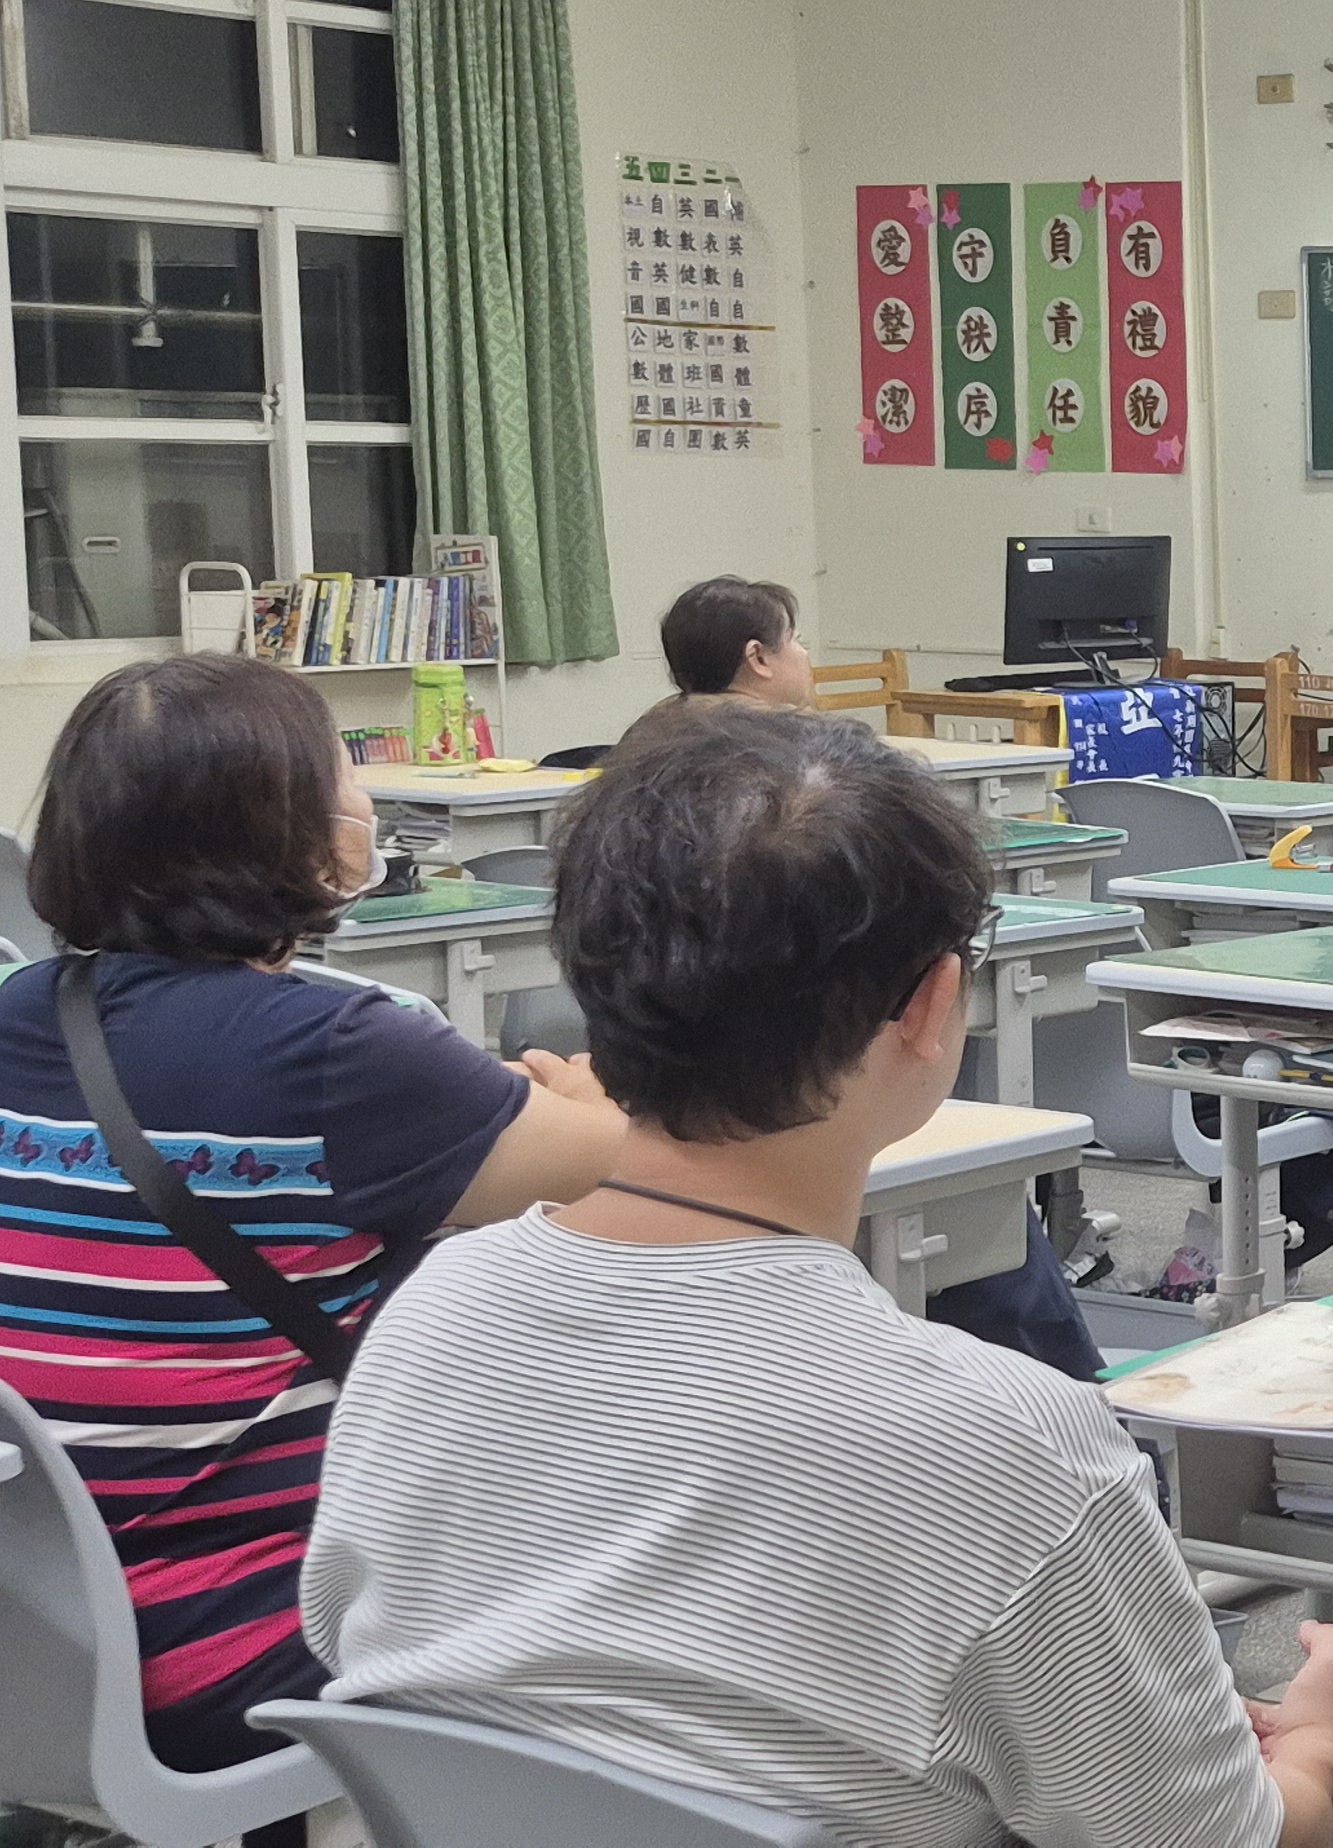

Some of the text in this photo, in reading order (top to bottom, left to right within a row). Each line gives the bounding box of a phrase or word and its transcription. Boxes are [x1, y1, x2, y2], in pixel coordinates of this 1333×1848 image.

[621, 155, 644, 181] 五
[647, 161, 671, 184] 四
[673, 163, 698, 186] 三
[702, 168, 723, 184] 二
[875, 224, 910, 428] 愛整潔
[956, 233, 992, 432] 守秩序
[1046, 217, 1079, 428] 負責任
[1124, 226, 1162, 430] 有禮貌
